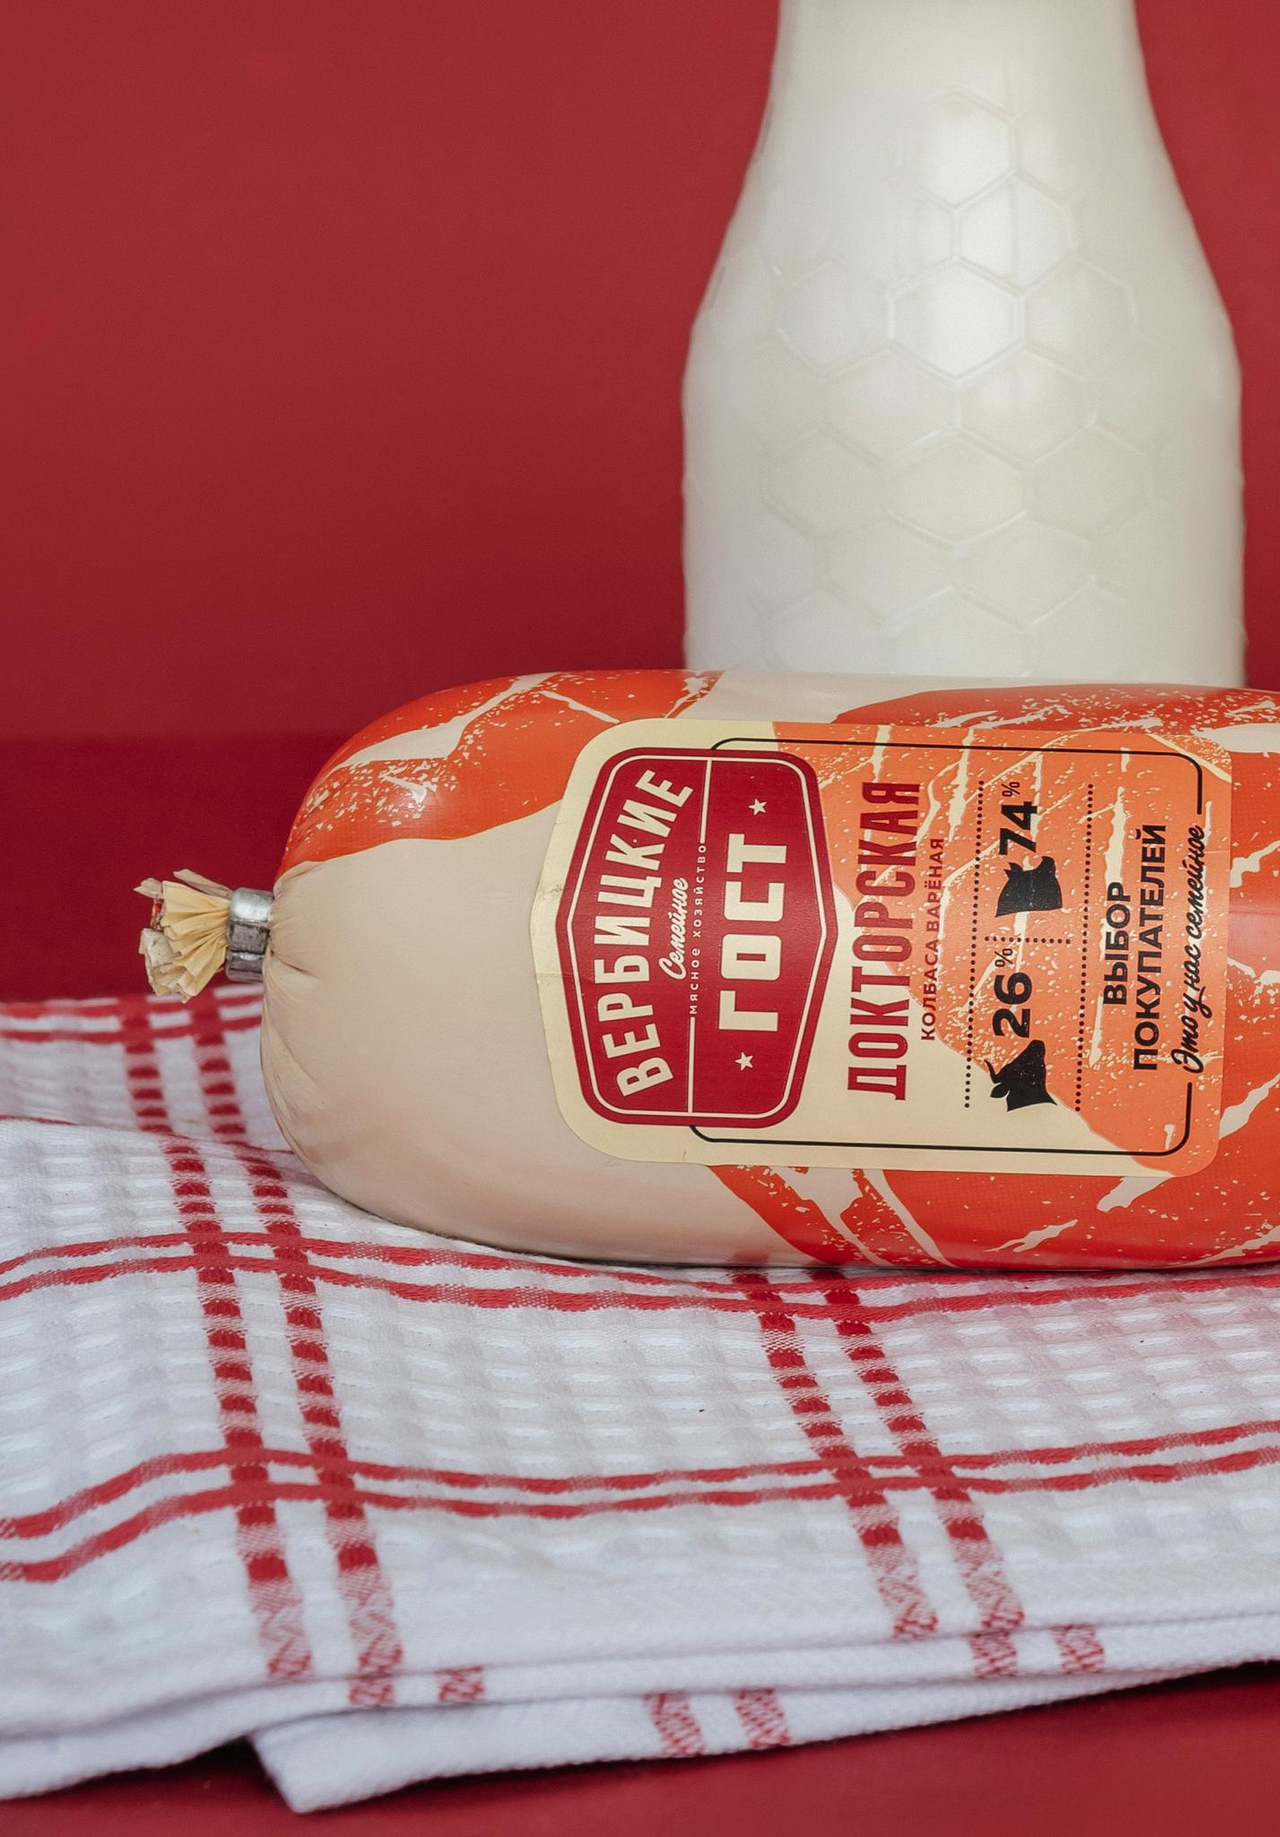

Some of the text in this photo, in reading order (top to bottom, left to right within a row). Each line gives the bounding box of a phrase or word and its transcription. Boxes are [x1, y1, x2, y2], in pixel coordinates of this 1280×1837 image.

[594, 769, 694, 1097] ВЕРБИЦКИЕ
[659, 877, 689, 980] Семейное
[718, 833, 787, 1032] ГОСТ
[847, 781, 921, 1101] ДОКТОРСКАЯ
[921, 837, 945, 1041] КОЛБАСА ВАРЁНАЯ
[1103, 882, 1131, 1005] ВЫБОР
[1133, 824, 1167, 1071] ПОКУПАТЕЛЕЙ
[1171, 824, 1212, 1074] Это у нас семейное
